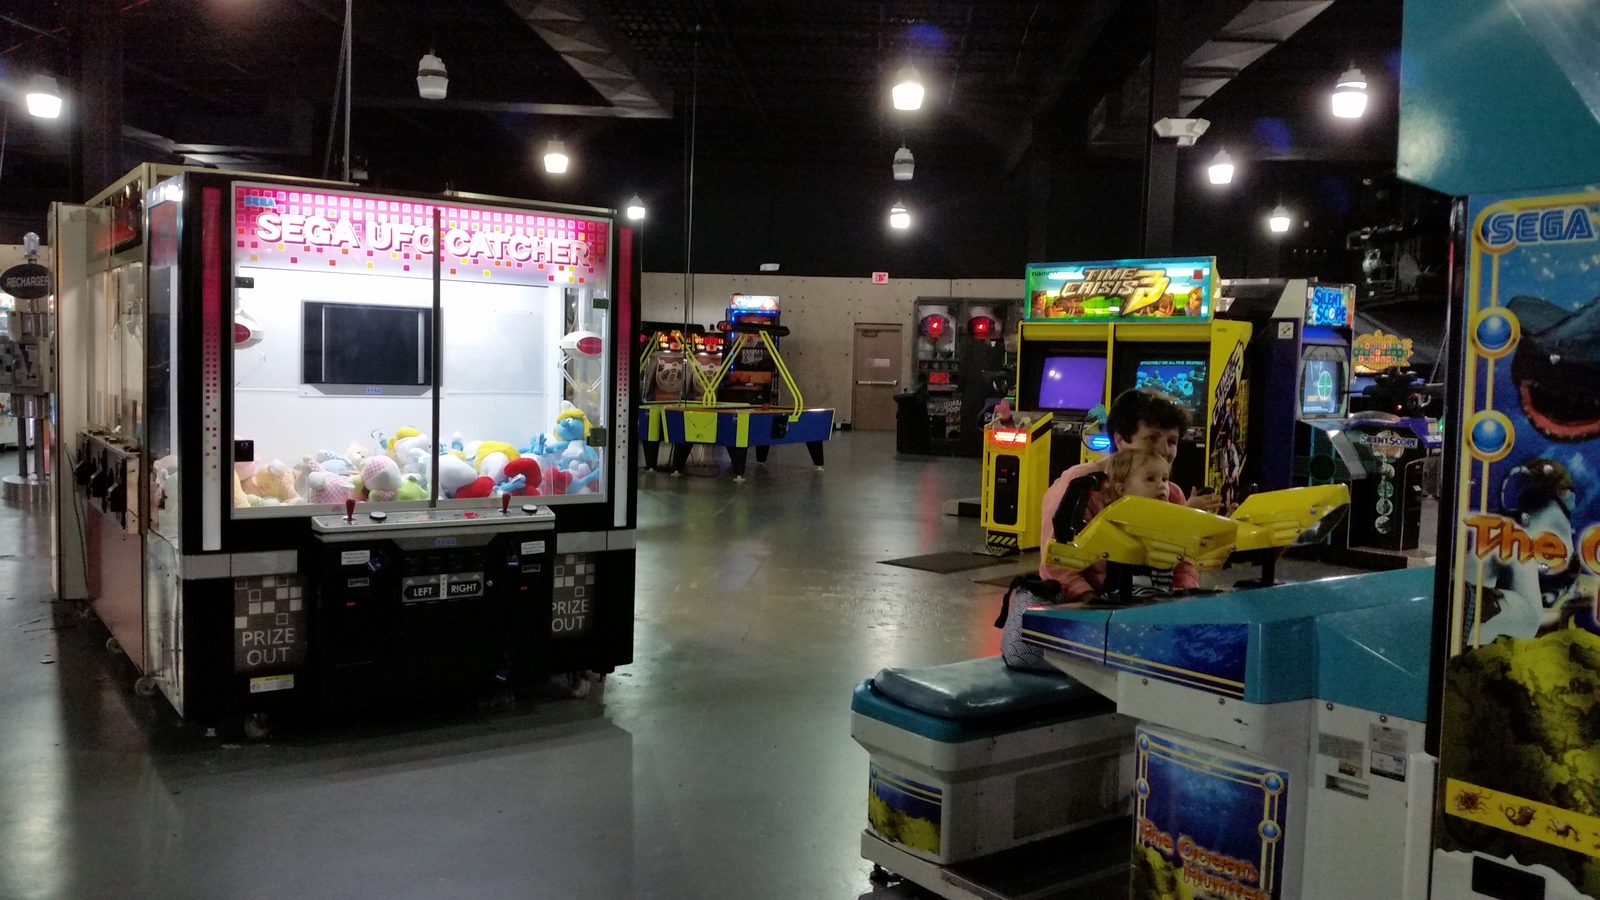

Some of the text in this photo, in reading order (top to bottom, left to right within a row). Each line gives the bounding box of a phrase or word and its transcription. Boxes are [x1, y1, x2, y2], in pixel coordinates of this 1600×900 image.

[244, 196, 277, 208] SEGA
[1490, 208, 1594, 246] SEGA
[257, 212, 591, 267] SEGA UFO CATCHER
[1084, 268, 1137, 281] TIME
[1061, 269, 1171, 316] CRISIS 3
[1314, 286, 1345, 305] SILENT
[1315, 305, 1348, 322] SCOPE
[1360, 434, 1418, 449] SILENT SCOPE
[1463, 514, 1568, 571] The
[413, 583, 478, 598] LEFT RIGHT
[552, 615, 586, 632] OUT
[242, 628, 295, 647] PRIZE
[247, 646, 291, 666] OUT
[1139, 818, 1259, 883] The Ocean
[1183, 860, 1271, 900] Hunter
